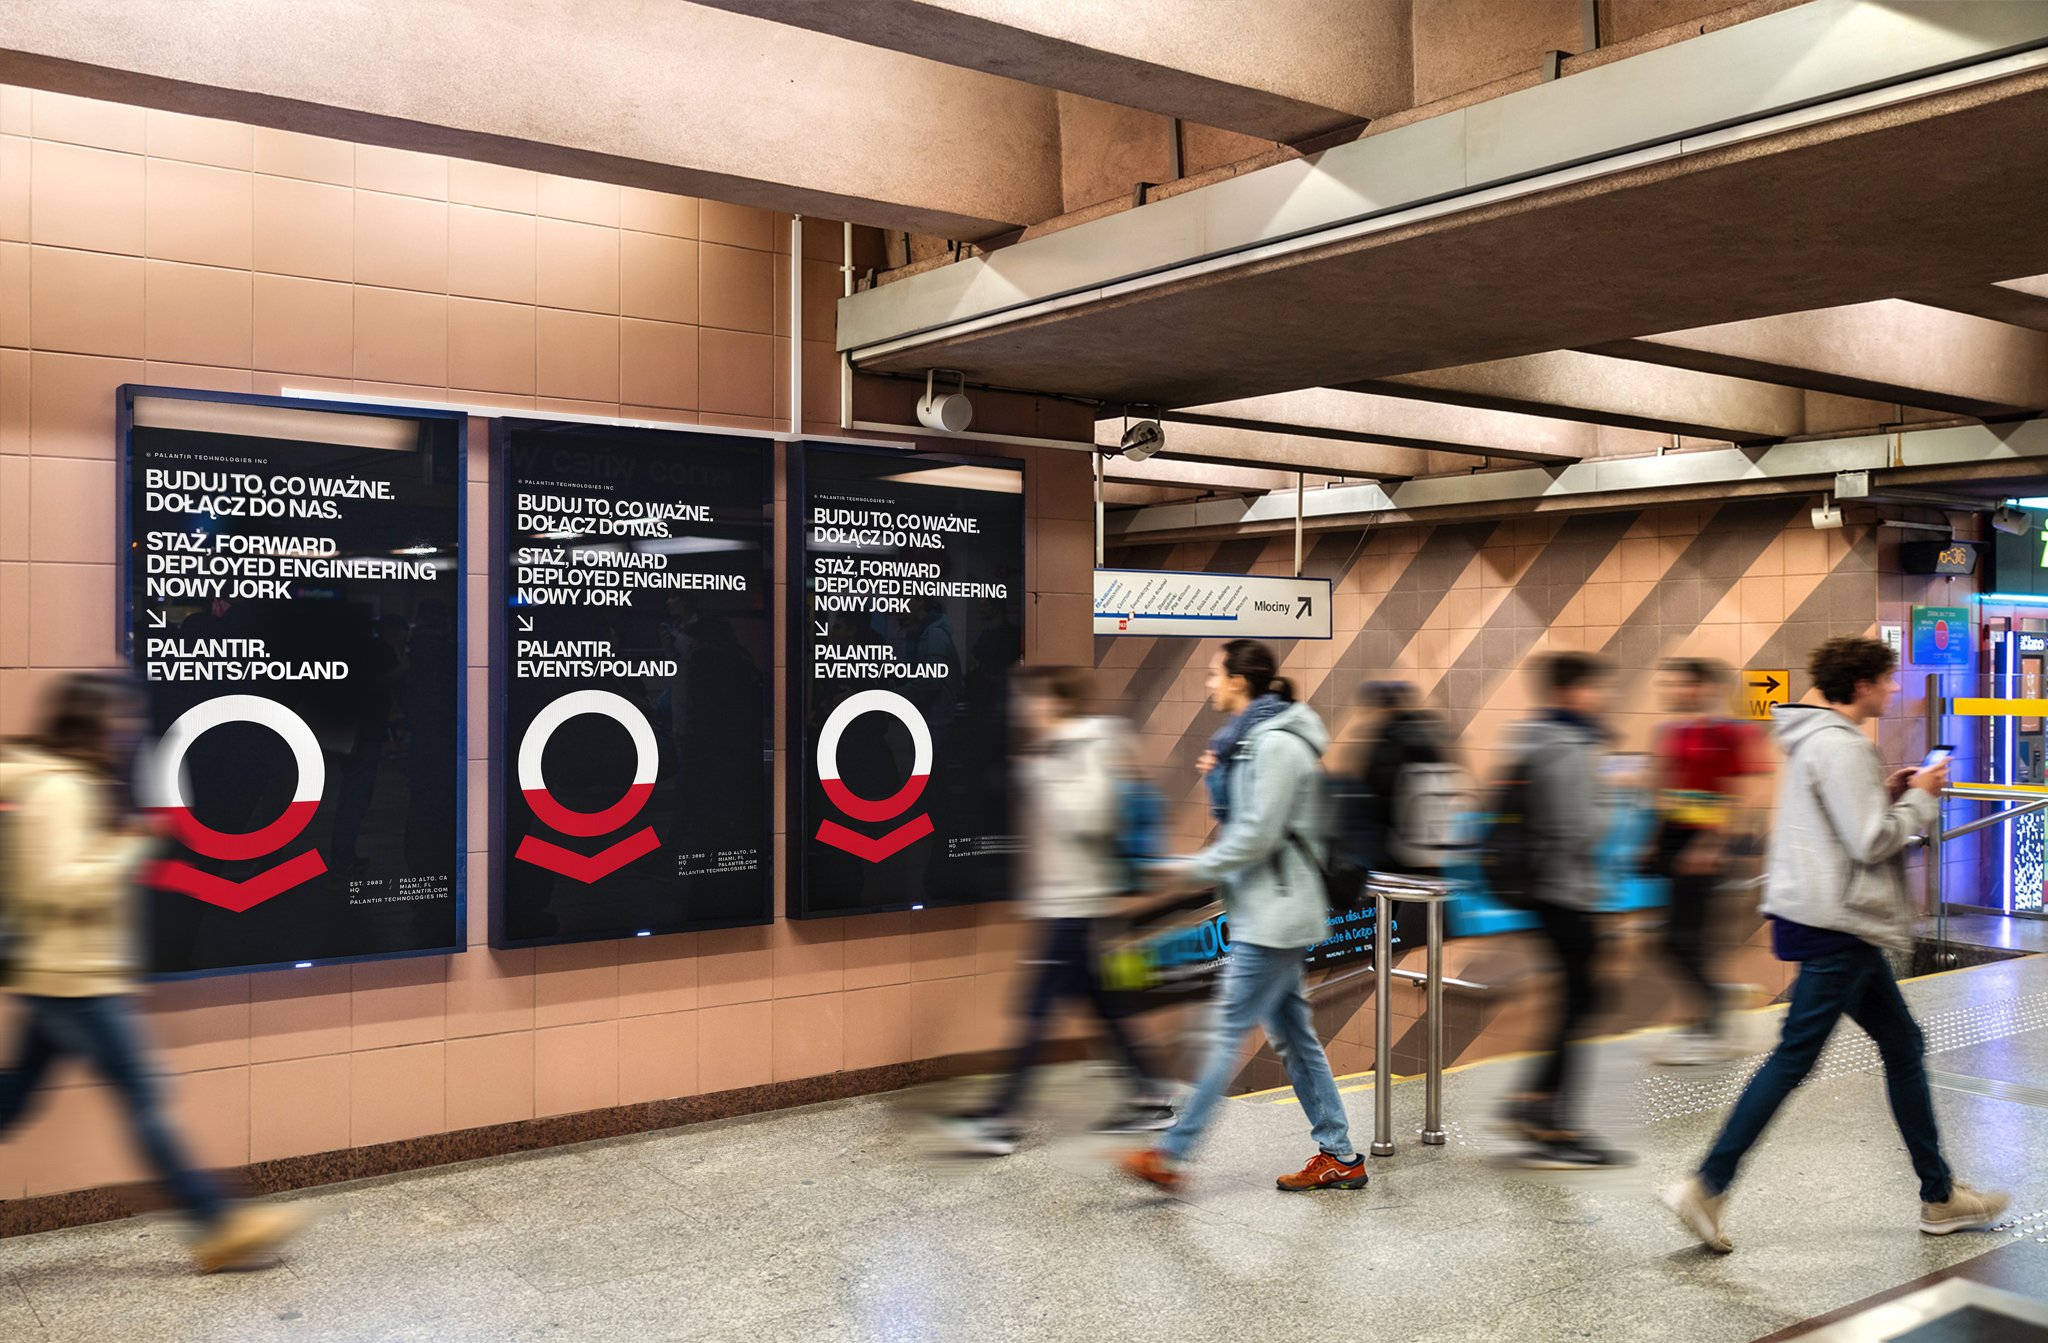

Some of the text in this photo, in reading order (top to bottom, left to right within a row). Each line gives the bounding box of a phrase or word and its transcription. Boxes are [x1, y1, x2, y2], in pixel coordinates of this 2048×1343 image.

[194, 454, 252, 463] TECHNOLOGIES
[146, 469, 395, 500] BUDUJ TO, CO WAŻNE.
[556, 481, 601, 490] TECHNOLOGIES
[146, 492, 342, 520] DOŁĄCZ DO NAS.
[517, 493, 714, 522] BUDUJ TO, CO WAŻNE.
[599, 519, 627, 535] DO
[631, 521, 673, 538] NAS.
[814, 508, 980, 534] BUDUJ TO, CO WAŻNE.
[147, 528, 336, 557] STAŻ, FORWARD
[814, 526, 945, 549] DOŁĄCZ DO NAS.
[147, 554, 437, 581] DEPLOYED ENGINEERING
[518, 544, 668, 570] STAŻ, FORWARD
[814, 555, 941, 579] STAŻ, FORWARD
[147, 577, 226, 599] NOWY
[229, 579, 292, 600] JORK
[517, 567, 747, 591] DEPLOYED ENGINEERING
[814, 577, 1007, 599] DEPLOYED ENGINEERING
[517, 587, 633, 607] NOWY JORK
[814, 595, 911, 613] NOWY JORK
[147, 638, 270, 659] PALANTIR.
[517, 640, 615, 658] PALANTIR.
[814, 644, 897, 661] PALANTIR.
[147, 660, 348, 682] EVENTS/POLAND
[517, 660, 678, 678] EVENTS/POLAND
[814, 662, 949, 679] EVENTS/POLAND
[384, 894, 434, 902] TECHNOLOGIES
[400, 887, 448, 895] PALANTIR.COM
